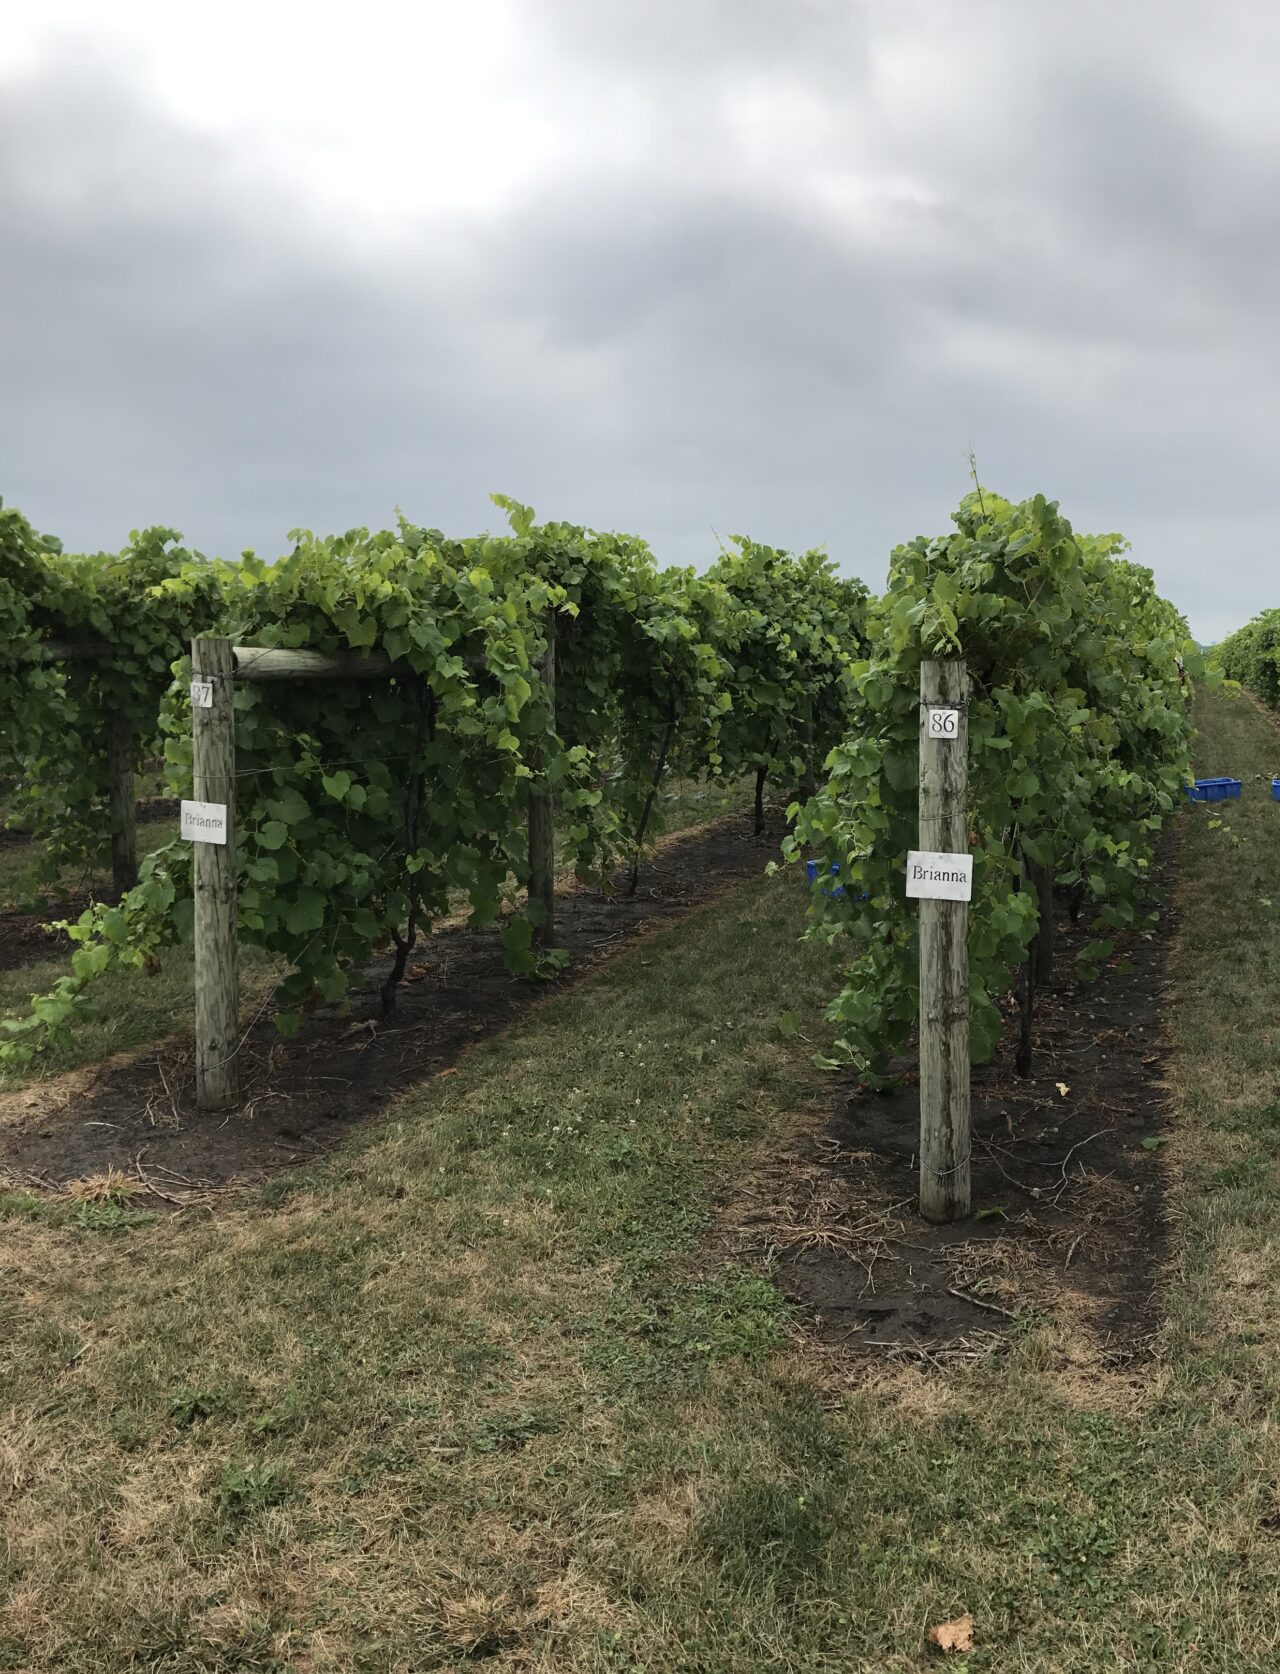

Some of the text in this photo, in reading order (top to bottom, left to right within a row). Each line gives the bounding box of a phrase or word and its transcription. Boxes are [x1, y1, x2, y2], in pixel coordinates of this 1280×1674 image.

[931, 713, 955, 733] 86
[185, 812, 224, 829] Brianna
[912, 865, 968, 883] Brianna
